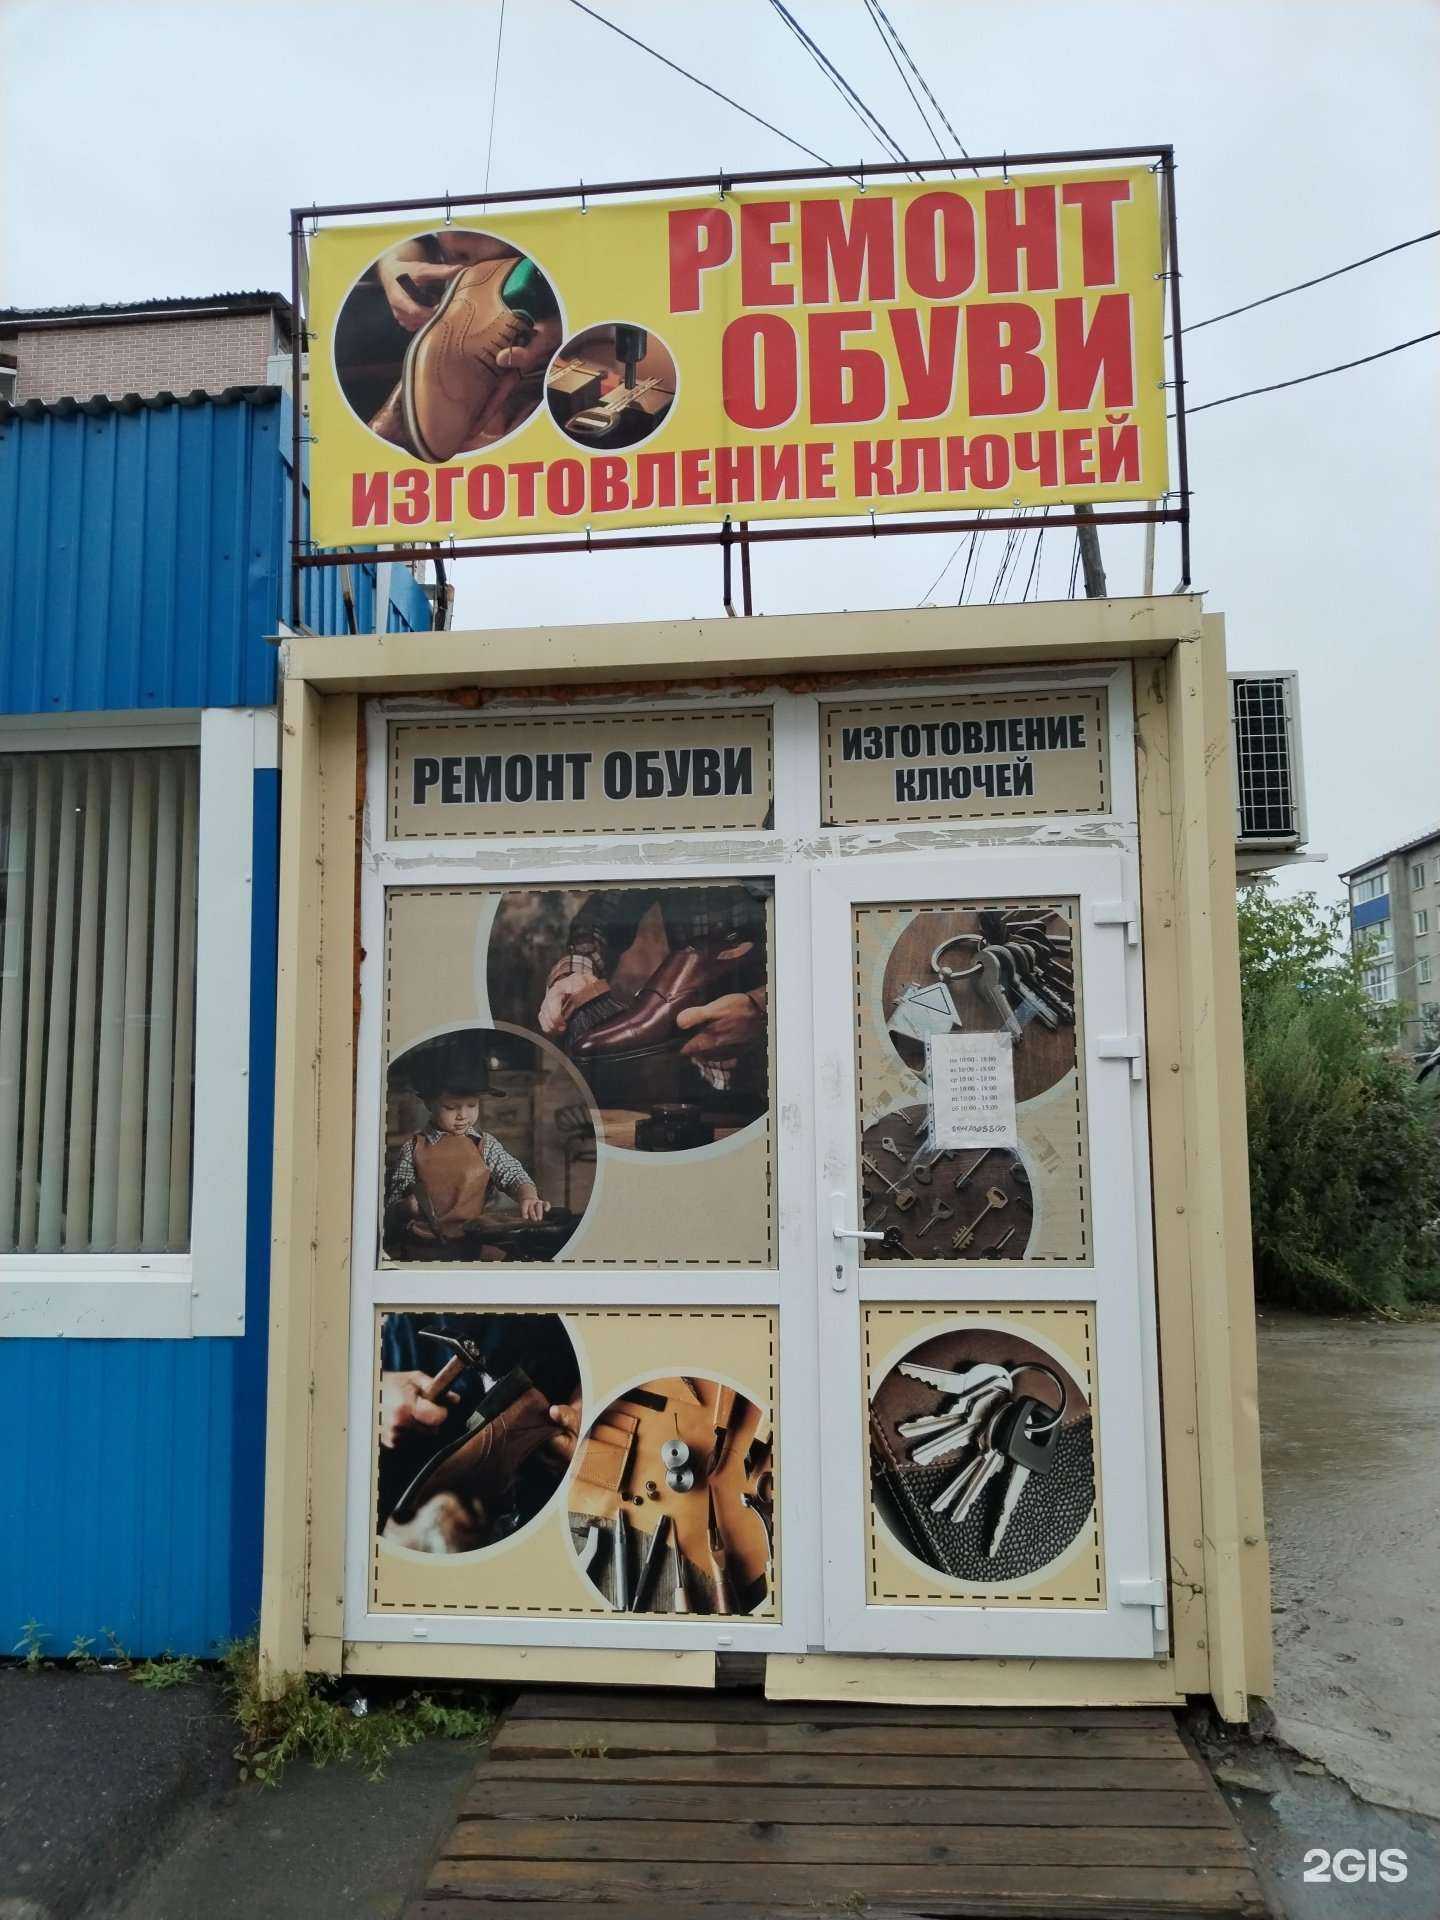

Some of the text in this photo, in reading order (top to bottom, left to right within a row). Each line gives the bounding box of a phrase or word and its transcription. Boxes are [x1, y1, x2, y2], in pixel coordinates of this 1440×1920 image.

[669, 180, 1130, 313] РЕМОНТ
[722, 293, 1134, 429] ОБУВИ
[352, 414, 1140, 527] ИЗГОТОВЛЕНИЕ КЛЮЧЕЙ
[413, 746, 753, 805] РЕМОНТ ОБУВИ
[841, 714, 1086, 761] ИЗГОТОВЛЕНИЕ
[895, 755, 1034, 803] КЛЮЧЕЙ
